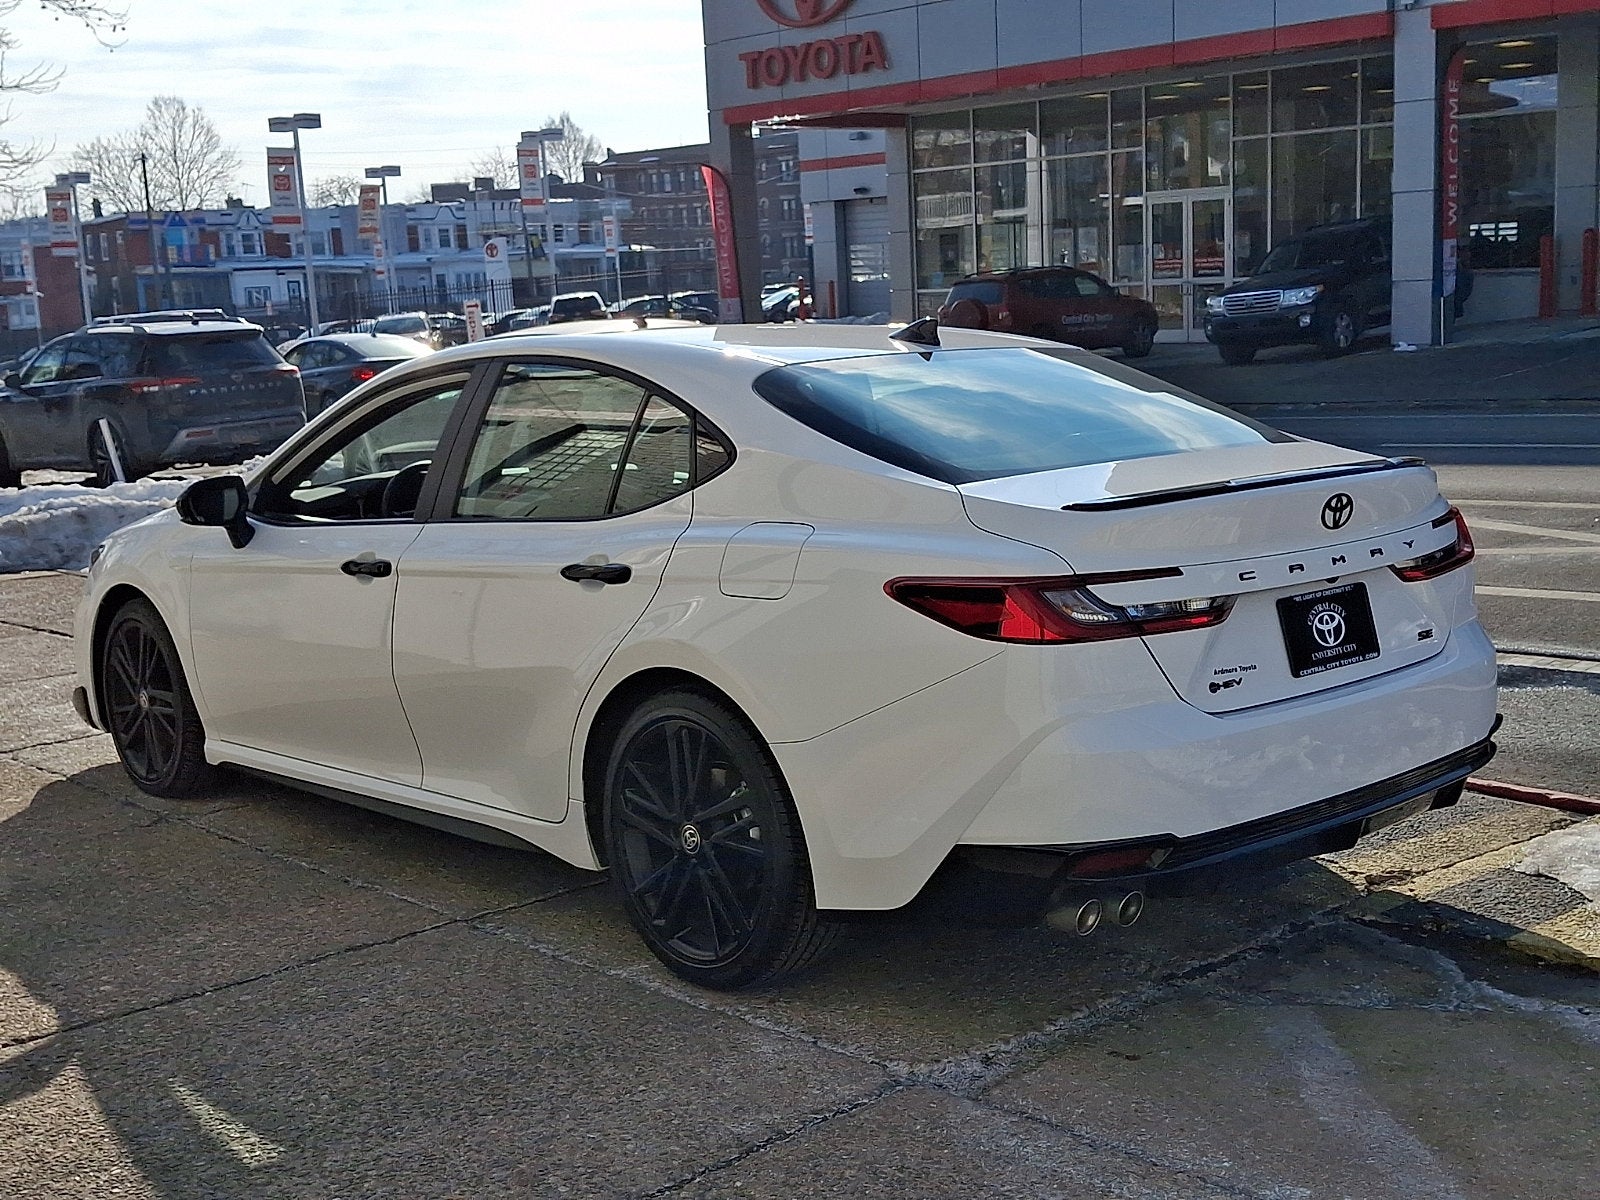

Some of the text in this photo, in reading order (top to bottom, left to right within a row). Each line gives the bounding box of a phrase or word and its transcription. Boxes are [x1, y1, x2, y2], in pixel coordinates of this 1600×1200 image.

[738, 31, 889, 89] TOYOTA
[1447, 79, 1460, 226] WELCOME
[189, 380, 282, 395] PATHFINDER
[1238, 539, 1416, 582] CAMRY
[1307, 601, 1347, 626] CENTRAL CITY
[1418, 628, 1433, 641] SE
[1311, 643, 1358, 661] UNIVERSITY CITY
[1213, 663, 1257, 676] Ardmore Toyota
[1299, 664, 1326, 676] CENTRAL
[1326, 660, 1340, 669] CITY
[1340, 655, 1364, 666] TOYOTA
